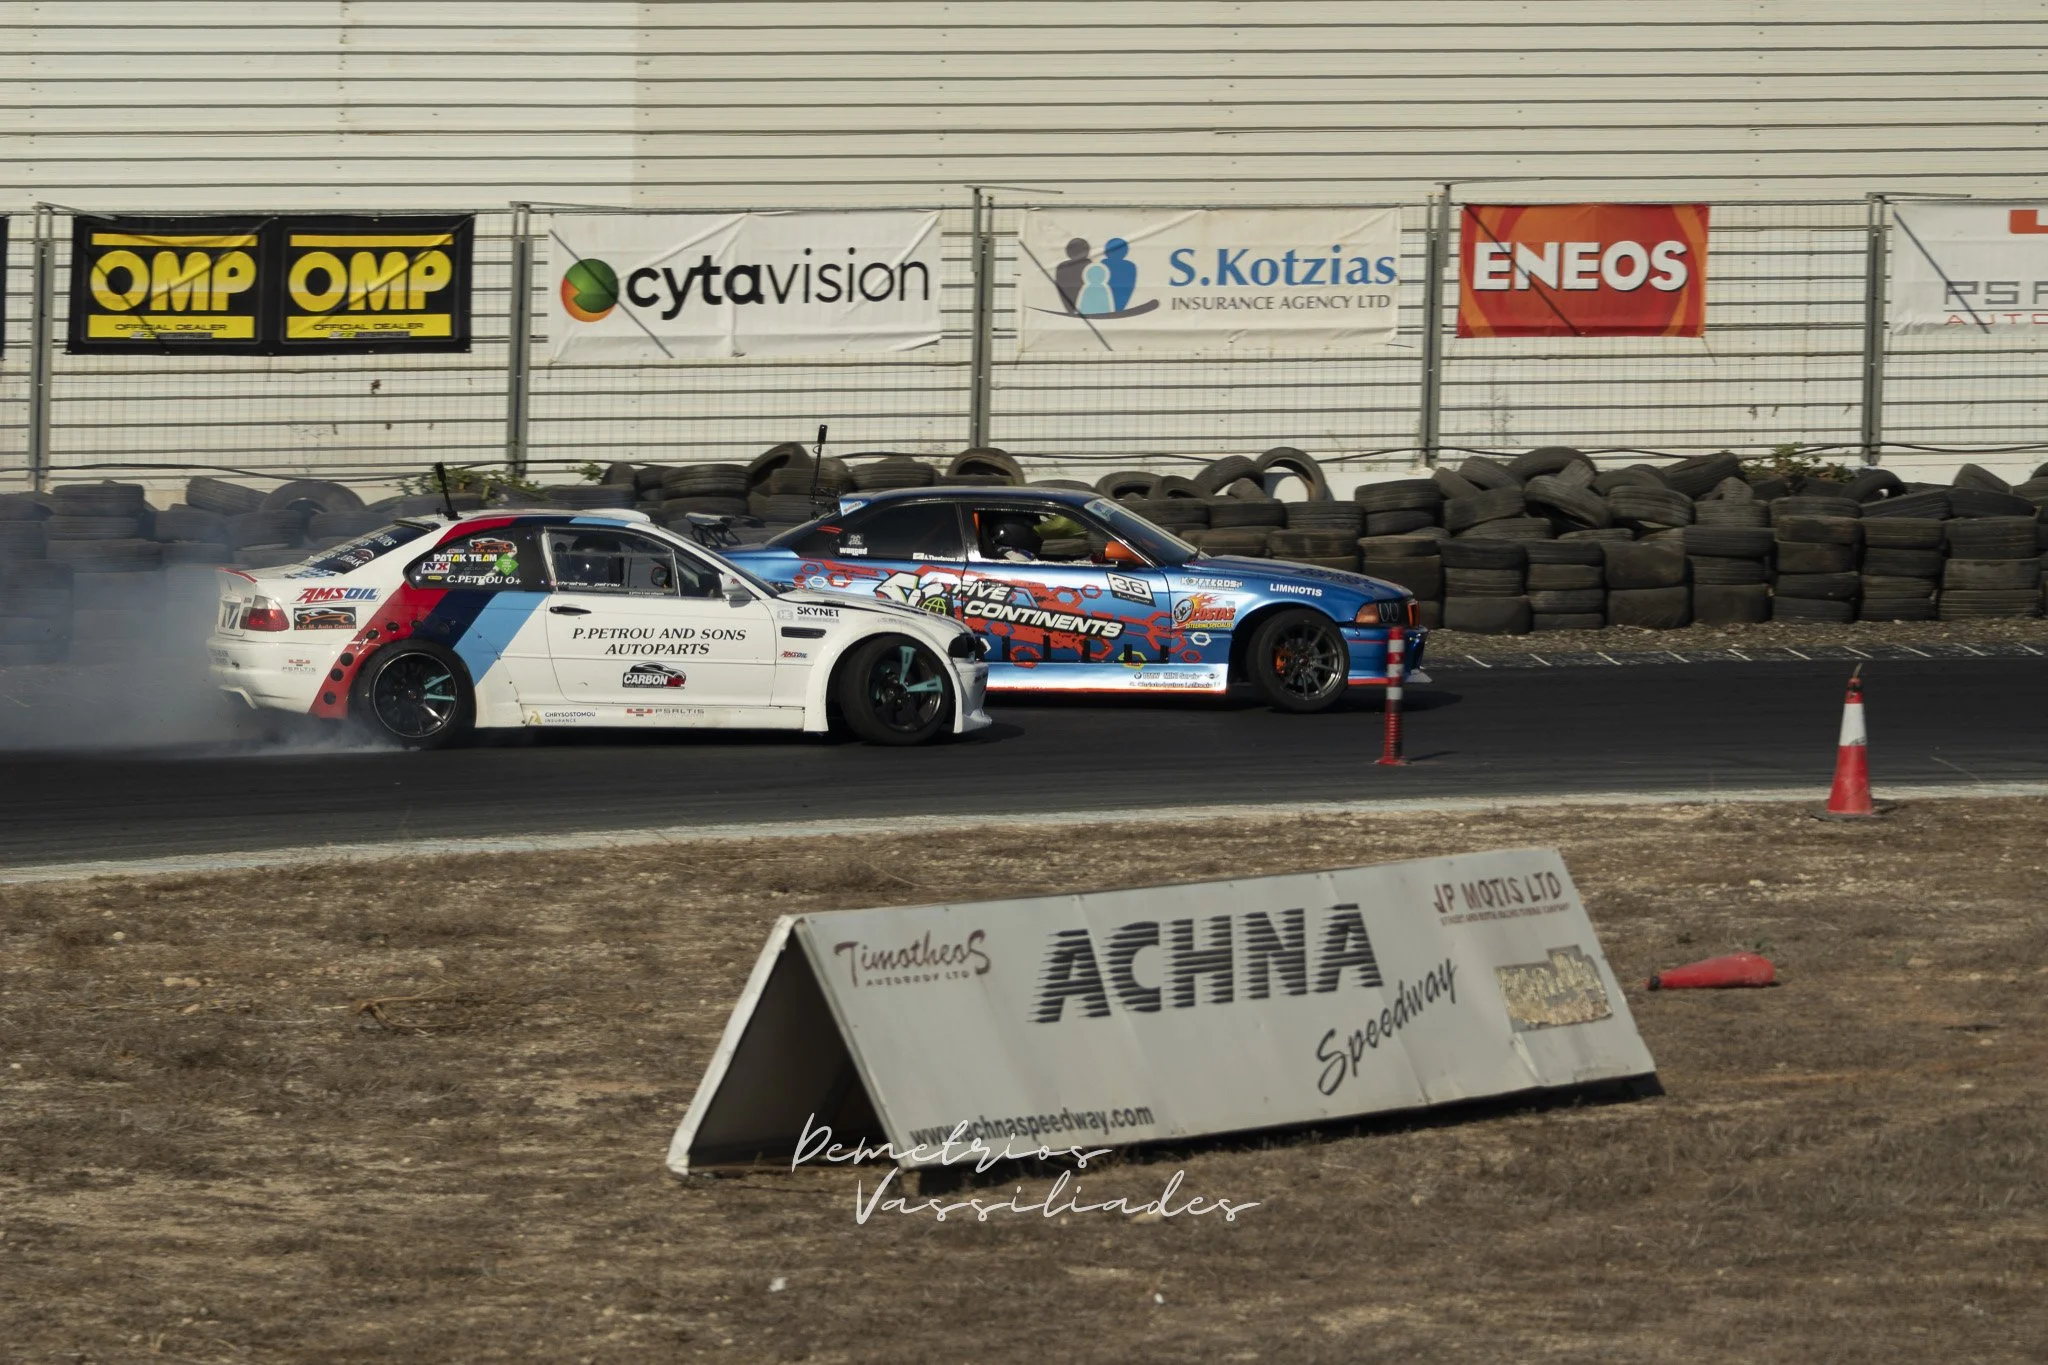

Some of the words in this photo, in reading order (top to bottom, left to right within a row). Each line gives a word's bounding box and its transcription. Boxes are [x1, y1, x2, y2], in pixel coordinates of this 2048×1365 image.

[1169, 244, 1397, 288] S.Kotzias
[1473, 240, 1688, 291] ENEOS
[90, 250, 256, 311] OMP
[288, 250, 452, 311] OMP
[627, 247, 929, 321] cytavision
[1171, 296, 1275, 311] INSURANCE
[1278, 295, 1351, 310] AGENCY
[1357, 294, 1391, 309] LTD
[115, 323, 171, 331] OFFICIAL
[175, 323, 228, 331] DEALER
[313, 323, 369, 331] OFFICIAL
[373, 322, 425, 330] DEALER
[433, 553, 467, 562] PATAK
[469, 553, 498, 562] TEAM
[423, 562, 449, 571] NX
[952, 581, 1012, 601] FIVE
[1112, 577, 1147, 596] 36
[1269, 583, 1323, 597] LIMNIOTIS
[296, 587, 378, 604] AMSOIL
[797, 606, 840, 618] SKYNET
[964, 600, 1123, 638] CONTINENTS
[1191, 607, 1236, 621] COSTAS
[572, 627, 656, 641] P.PETROU
[659, 628, 696, 640] AND
[700, 628, 746, 641] SONS
[605, 643, 710, 656] AUTOPARTS
[624, 674, 668, 685] CARBON
[1433, 883, 1455, 914] JP
[1524, 871, 1562, 903] LTD
[1027, 903, 1384, 1025] ACHNA
[945, 970, 971, 980] LTD
[1316, 957, 1459, 1097] Speedway
[909, 1103, 1156, 1148] www.achnaspeedway.com
